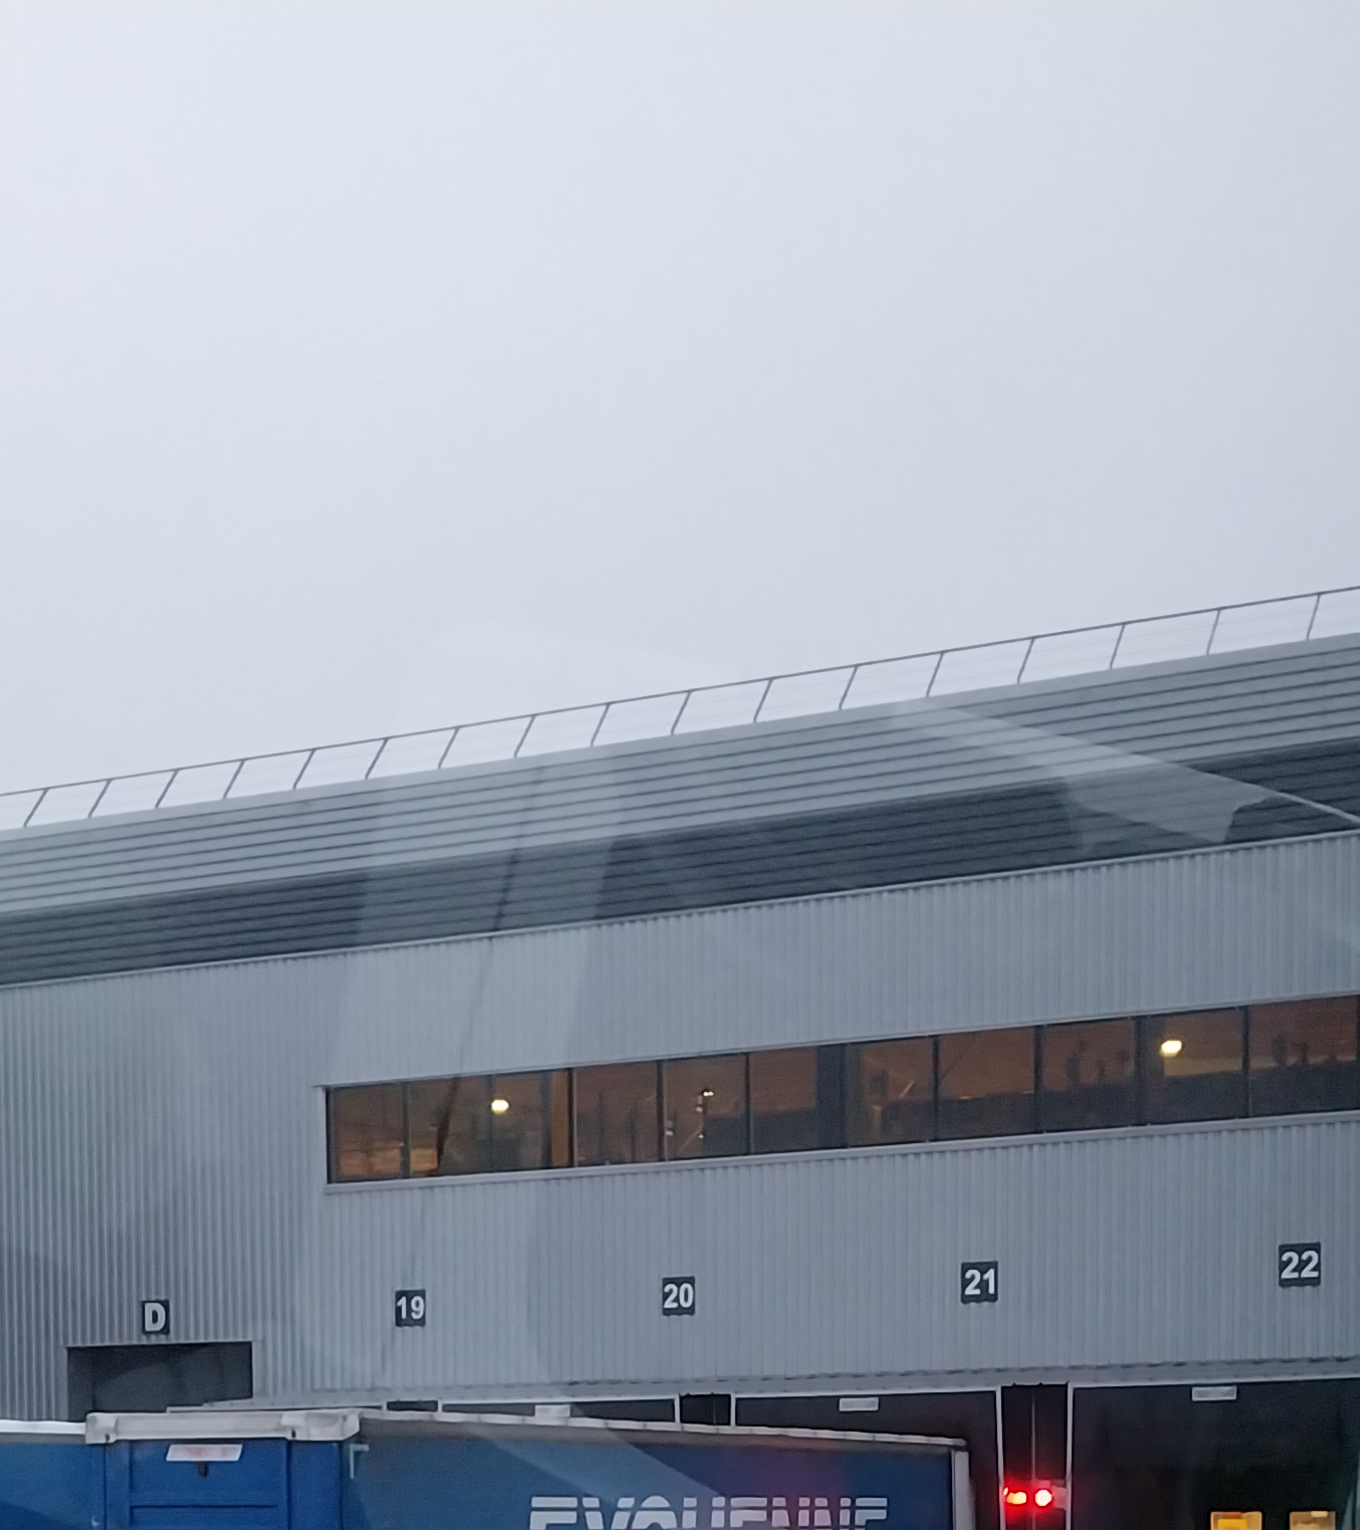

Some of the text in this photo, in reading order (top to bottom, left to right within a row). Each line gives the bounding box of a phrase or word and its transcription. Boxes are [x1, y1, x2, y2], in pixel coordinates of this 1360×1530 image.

[1281, 1250, 1319, 1279] 22
[964, 1268, 995, 1295] 21
[396, 1295, 425, 1320] 19
[663, 1282, 694, 1309] 20
[144, 1302, 166, 1332] D
